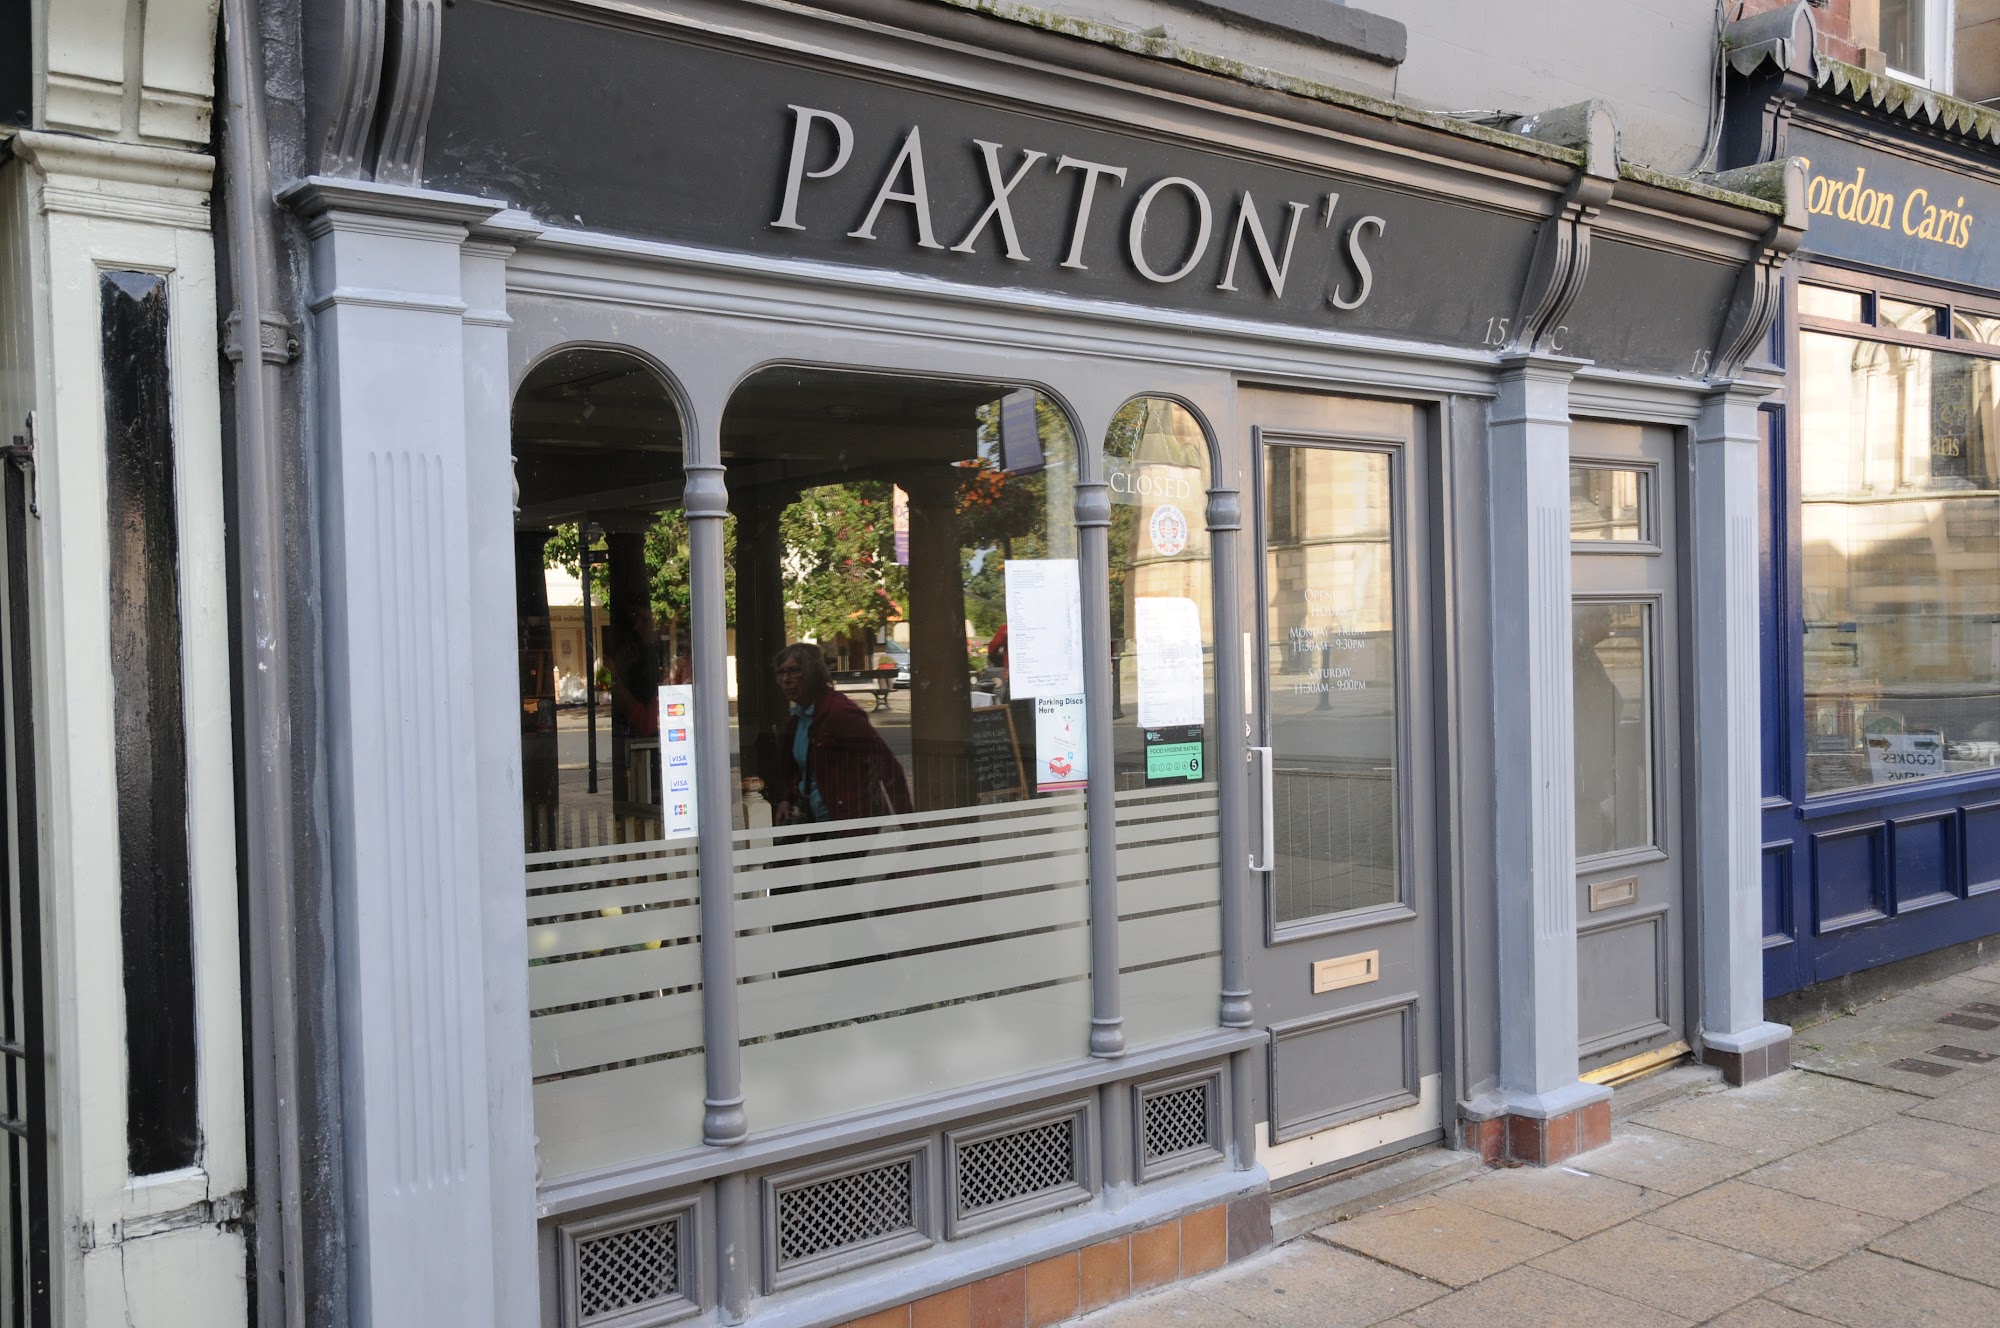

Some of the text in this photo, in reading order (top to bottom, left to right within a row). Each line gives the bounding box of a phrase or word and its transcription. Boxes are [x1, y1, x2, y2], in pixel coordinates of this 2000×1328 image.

[769, 103, 1387, 311] PAXTON'S
[1800, 156, 1973, 249] ordon Caris
[1482, 316, 1509, 345] 15
[1690, 349, 1711, 374] 15
[1931, 429, 1960, 457] aris
[1110, 472, 1191, 499] CLOSED
[1289, 627, 1330, 638] MONDAY
[1337, 626, 1366, 636] FRIDAY
[1335, 639, 1365, 650] 9:30PM
[1308, 667, 1351, 679] SATURDAY
[1336, 680, 1366, 691] 9:00PM
[1038, 697, 1083, 706] Parking Discs
[1038, 706, 1054, 714] Here
[672, 754, 687, 762] VISA
[1191, 760, 1197, 770] 5
